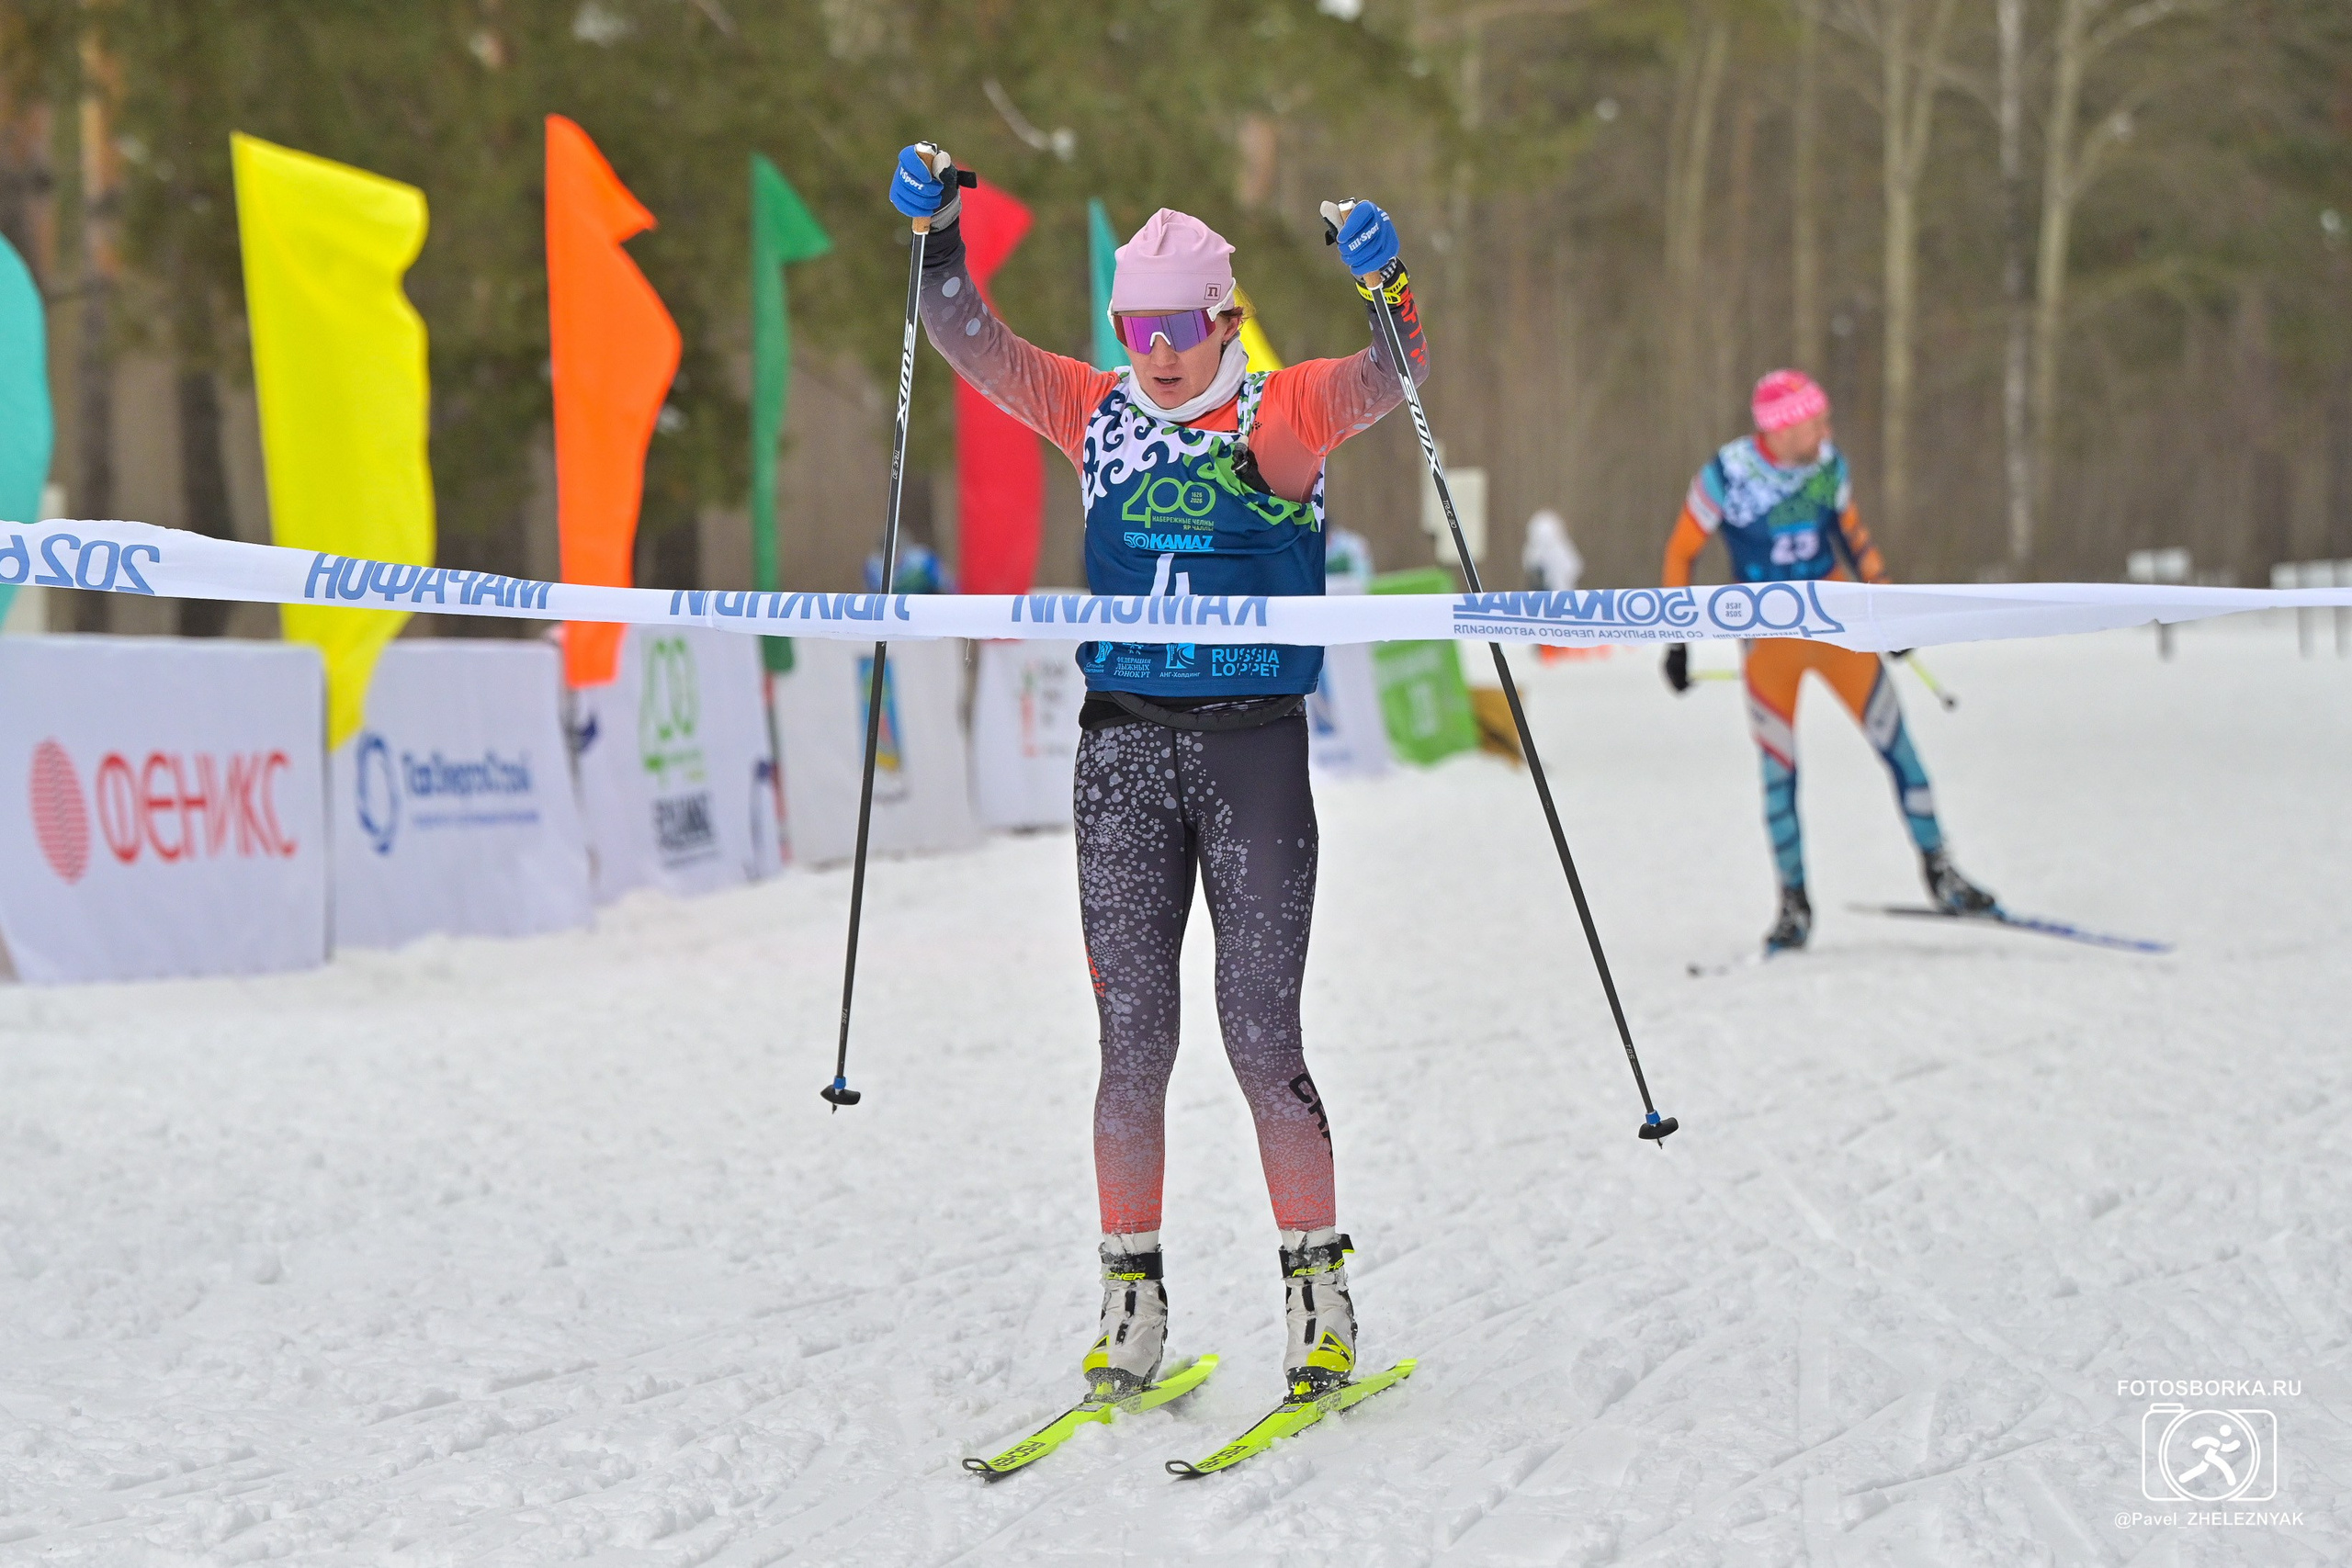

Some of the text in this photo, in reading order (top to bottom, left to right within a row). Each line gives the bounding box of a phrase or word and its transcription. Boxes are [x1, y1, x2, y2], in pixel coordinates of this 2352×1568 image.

[897, 320, 913, 432] SWIX
[1402, 374, 1444, 480] SWIX
[1122, 472, 1216, 529] 400
[1152, 515, 1215, 527] НАБЕРЕЖНЫЕ ЧЕЛНЫ
[1150, 534, 1215, 550] KAMAZ
[1116, 656, 1151, 664] ФЕДЕРАЦИЯ
[1212, 649, 1280, 664] RUSSIA
[1115, 663, 1150, 671] ЛЫЖНЫХ
[1212, 663, 1280, 678] LOPPET
[1293, 1258, 1344, 1277] FISHER
